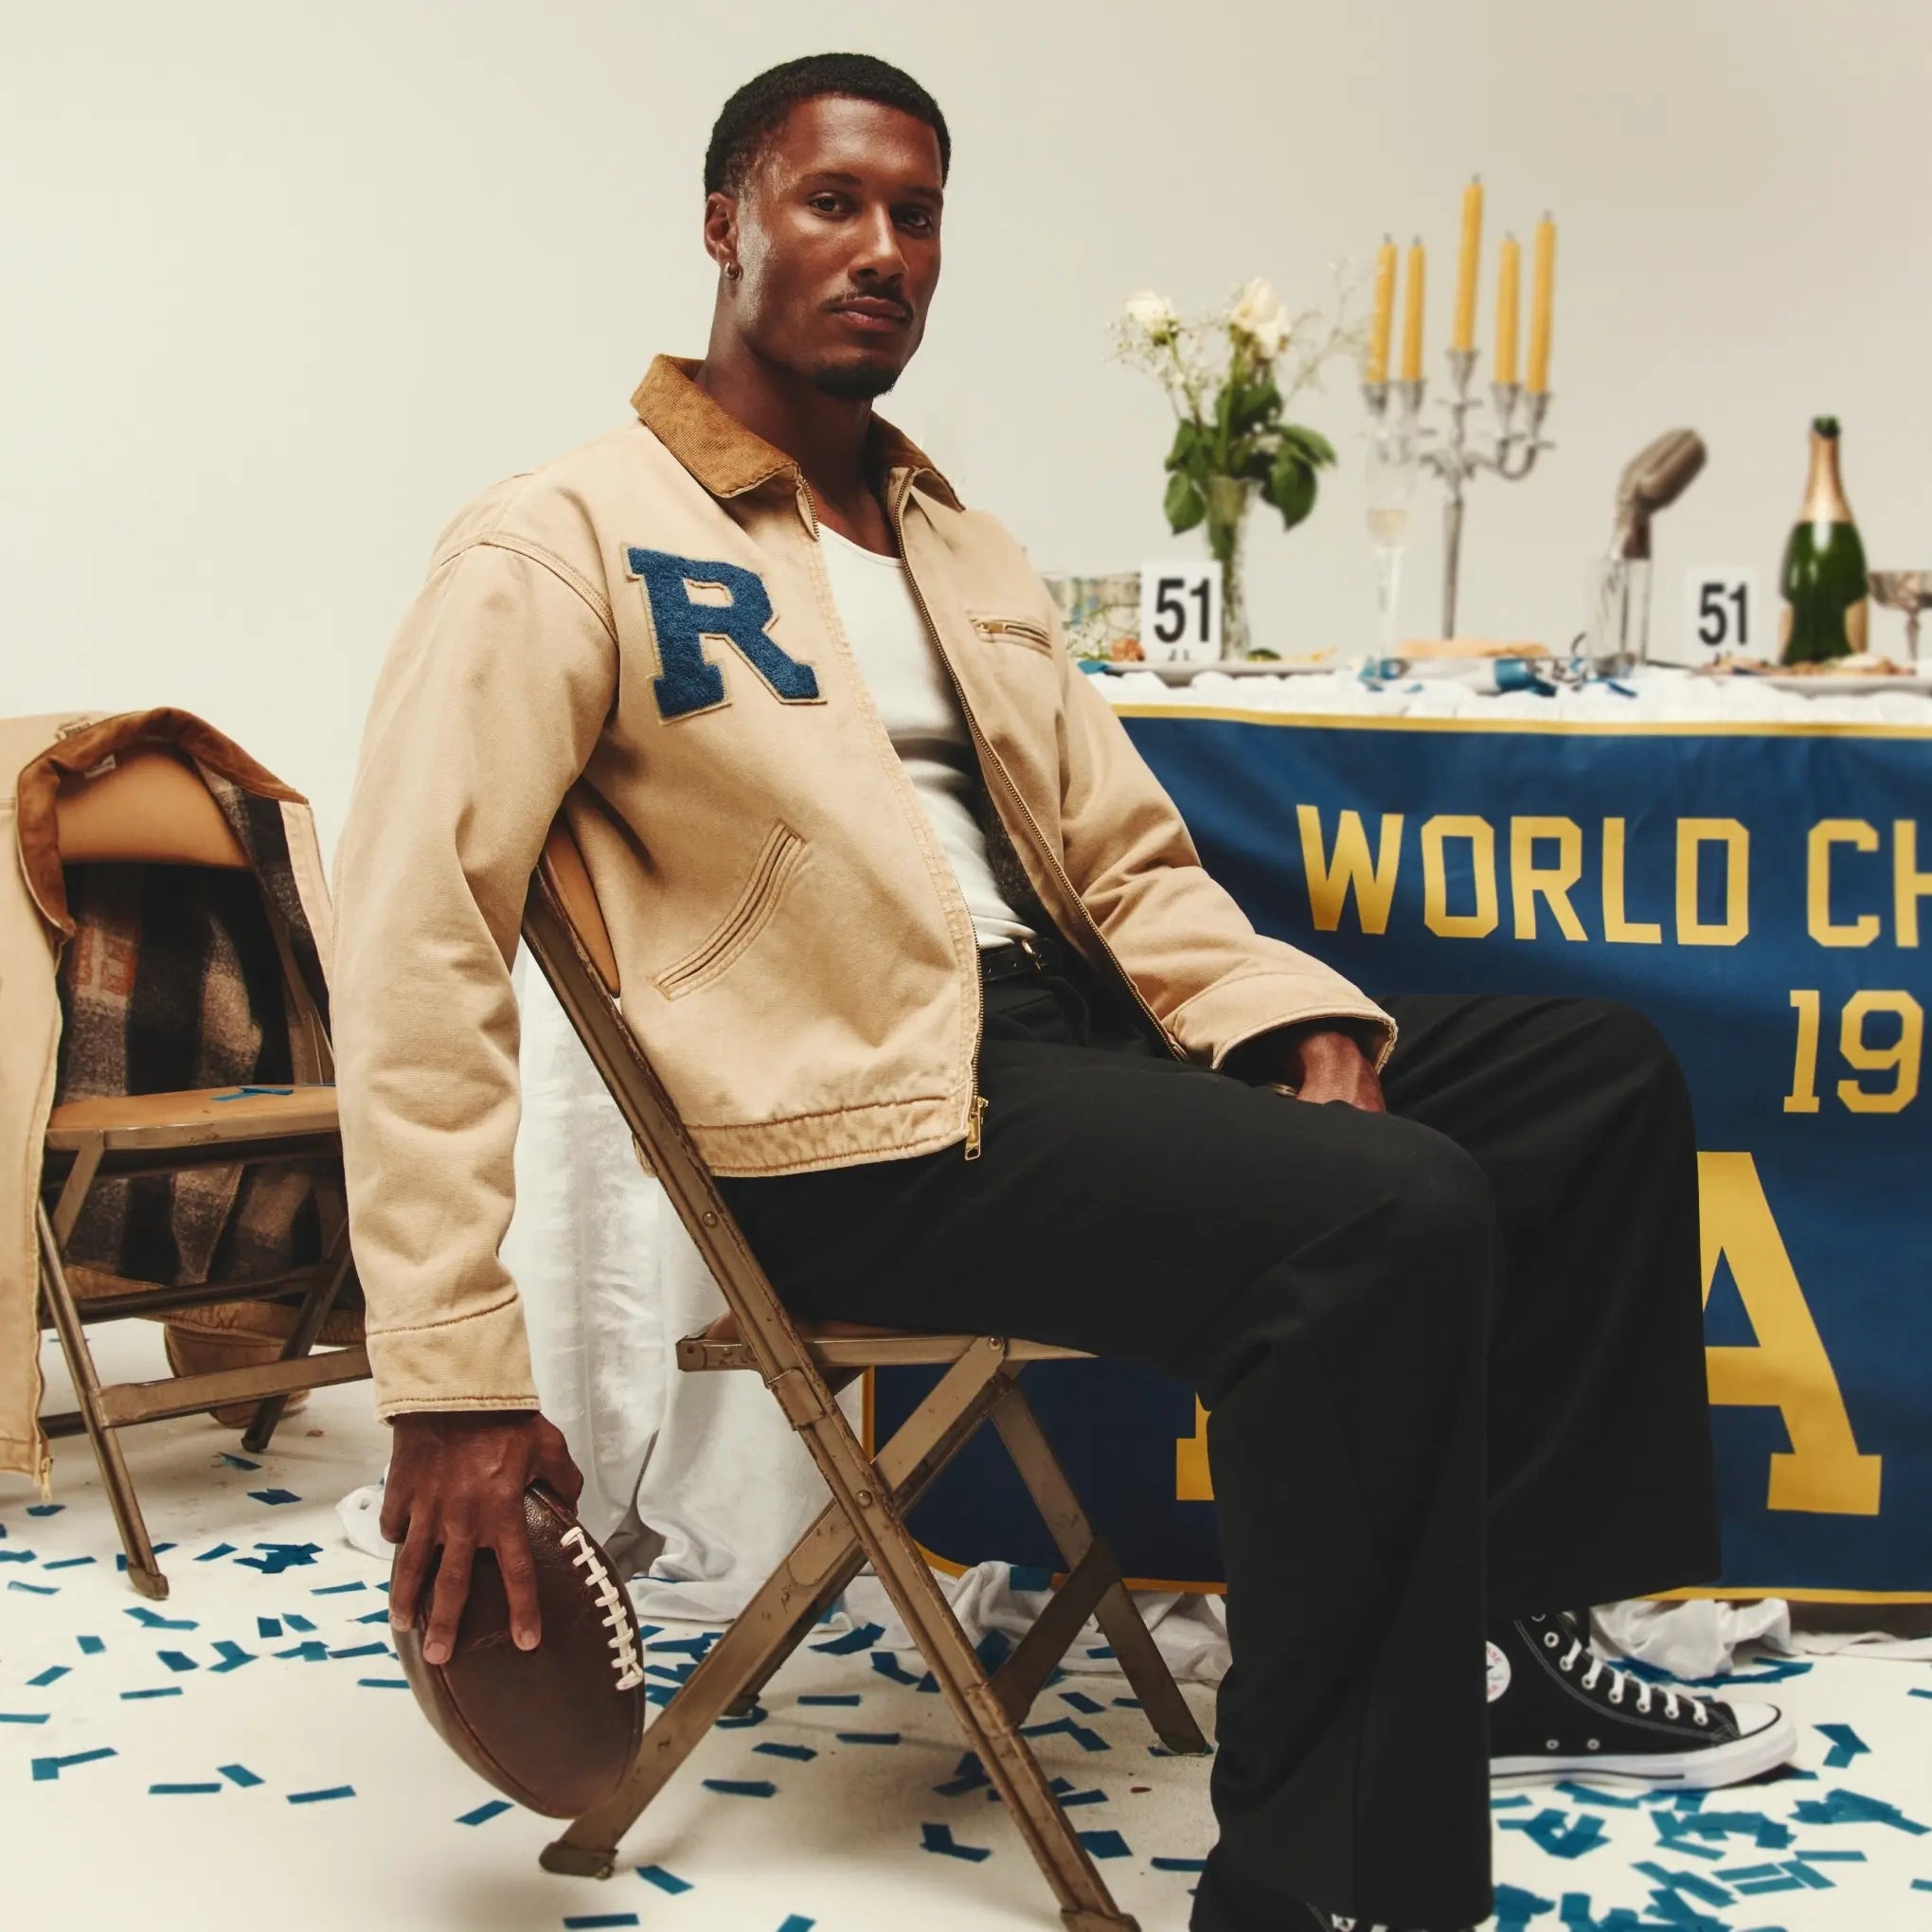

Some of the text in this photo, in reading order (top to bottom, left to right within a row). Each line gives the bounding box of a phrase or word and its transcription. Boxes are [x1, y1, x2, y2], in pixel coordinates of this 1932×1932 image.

[622, 543, 820, 717] R
[1154, 578, 1210, 644] 51
[1699, 582, 1747, 646] 51
[1297, 804, 1932, 948] WORLD CH
[1783, 990, 1923, 1113] 19
